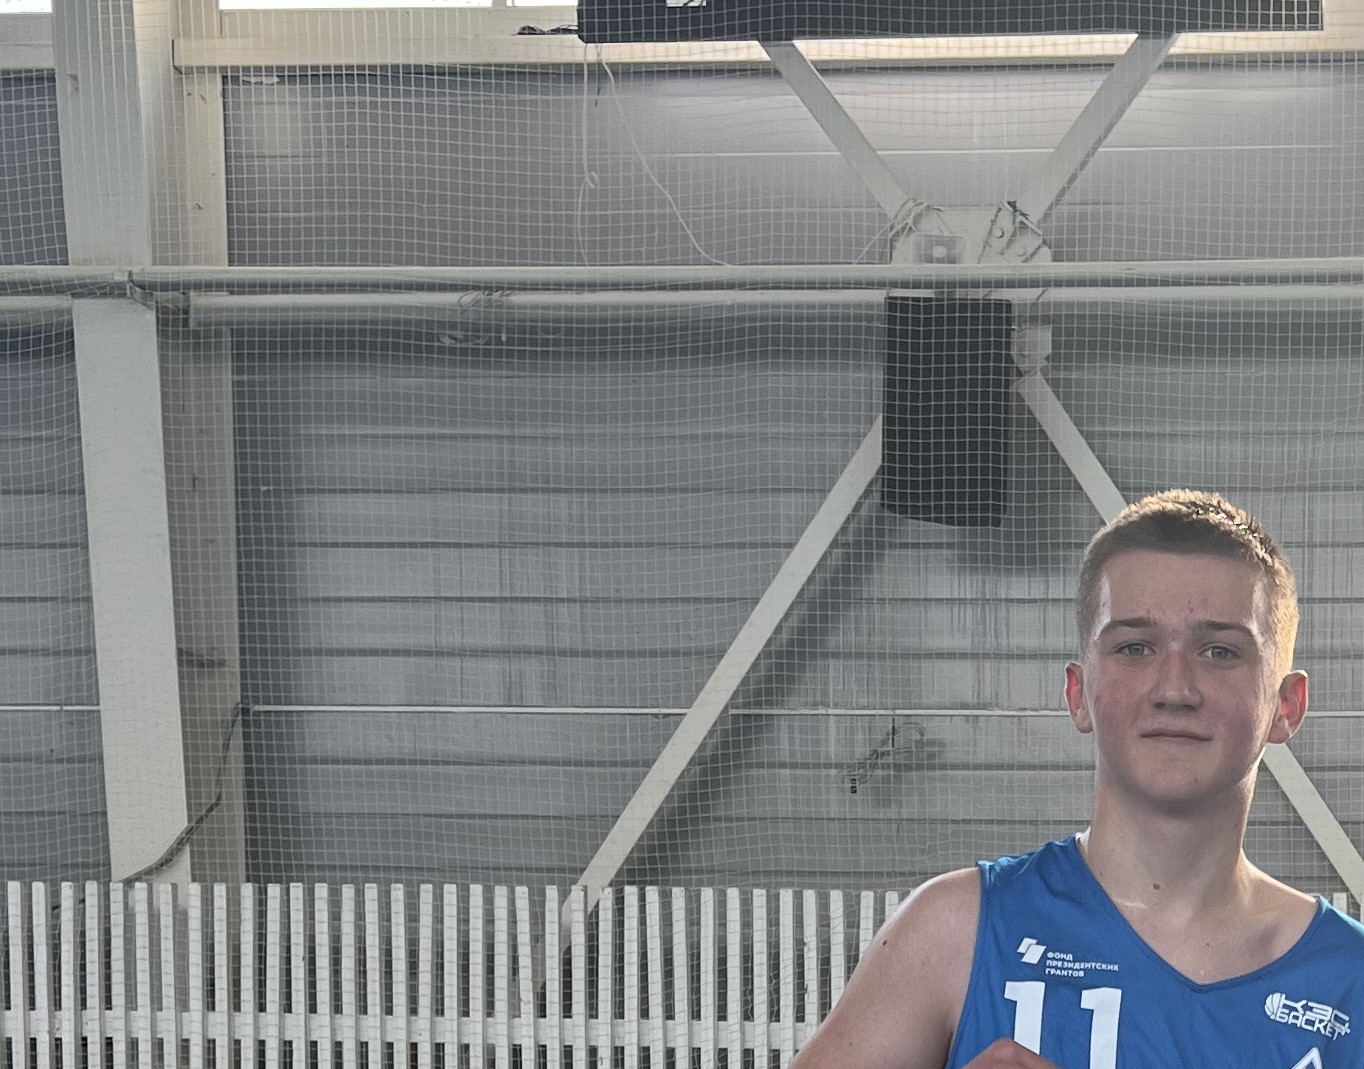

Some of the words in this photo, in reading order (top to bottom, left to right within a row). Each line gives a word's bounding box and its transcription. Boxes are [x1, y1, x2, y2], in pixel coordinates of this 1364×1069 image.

[1046, 951, 1074, 962] ФОНД
[1045, 960, 1119, 972] ПРЕЗИДЕНТСКИХ
[1045, 968, 1086, 978] ГРАНТОВ
